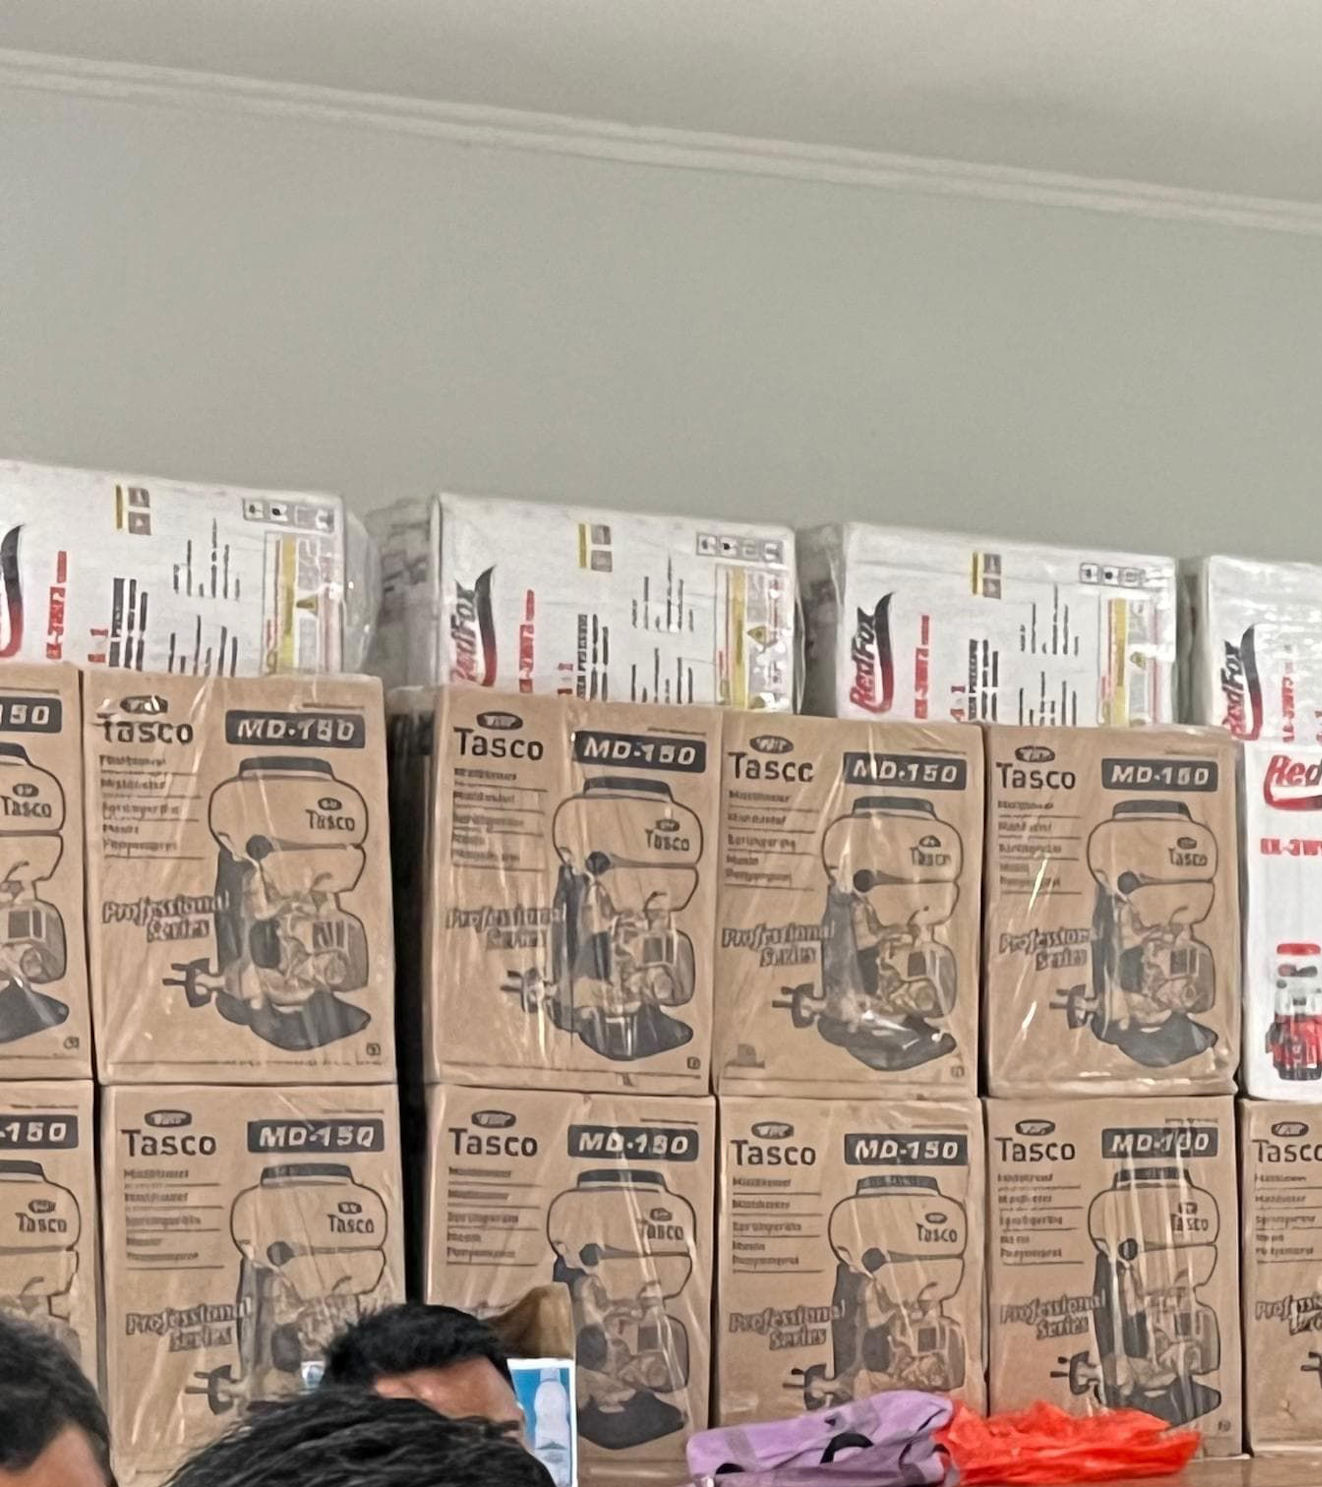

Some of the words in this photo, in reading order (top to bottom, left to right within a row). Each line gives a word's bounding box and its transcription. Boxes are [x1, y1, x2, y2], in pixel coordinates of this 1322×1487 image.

[453, 727, 544, 761] Tasco
[996, 761, 1077, 790] Tasco
[121, 1129, 218, 1157] Tasco
[259, 1124, 376, 1148] MD-150
[448, 1127, 538, 1157] Tasco
[854, 1139, 959, 1160] MD-150
[995, 1137, 1076, 1162] Tasco
[730, 1139, 817, 1166] Tasco
[328, 1212, 376, 1235] Tasco
